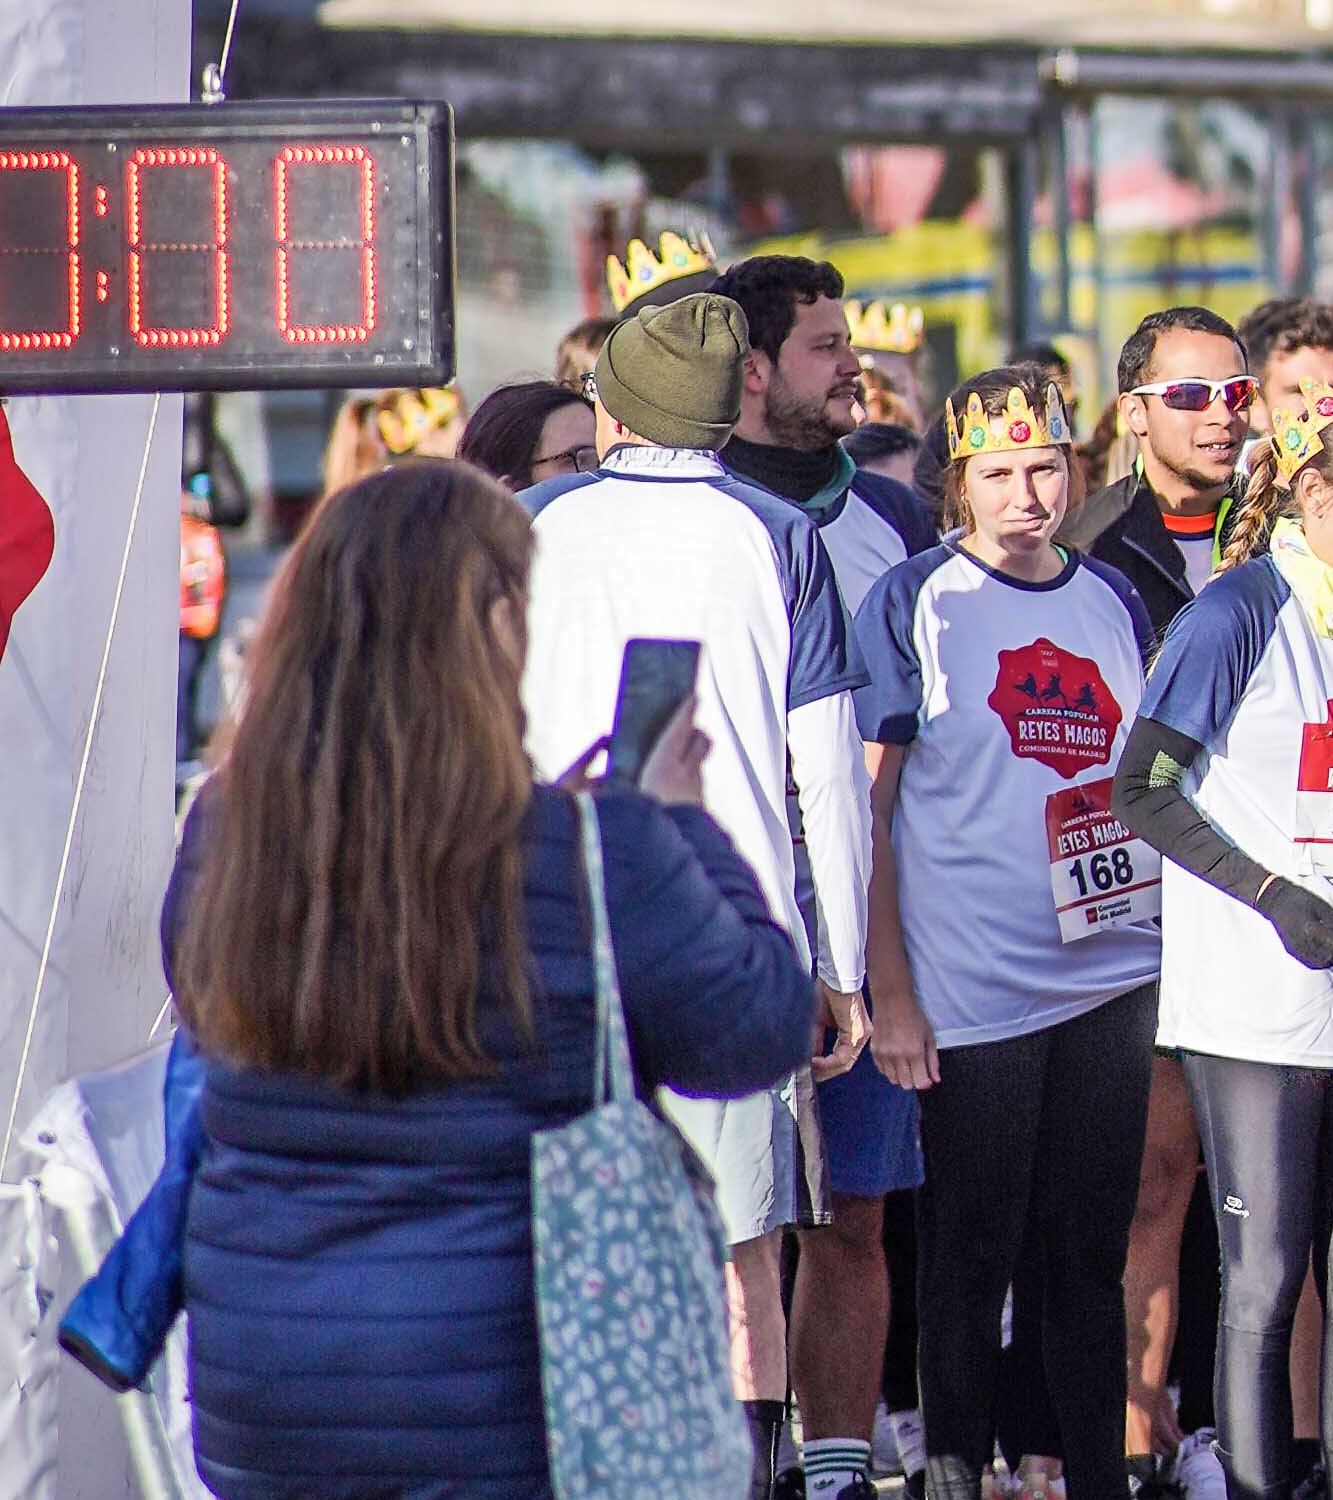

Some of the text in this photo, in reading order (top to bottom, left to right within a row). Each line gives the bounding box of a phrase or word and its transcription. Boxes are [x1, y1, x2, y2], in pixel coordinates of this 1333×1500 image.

[1019, 721, 1107, 746] REYES MAGOS
[1069, 847, 1134, 896] 168
